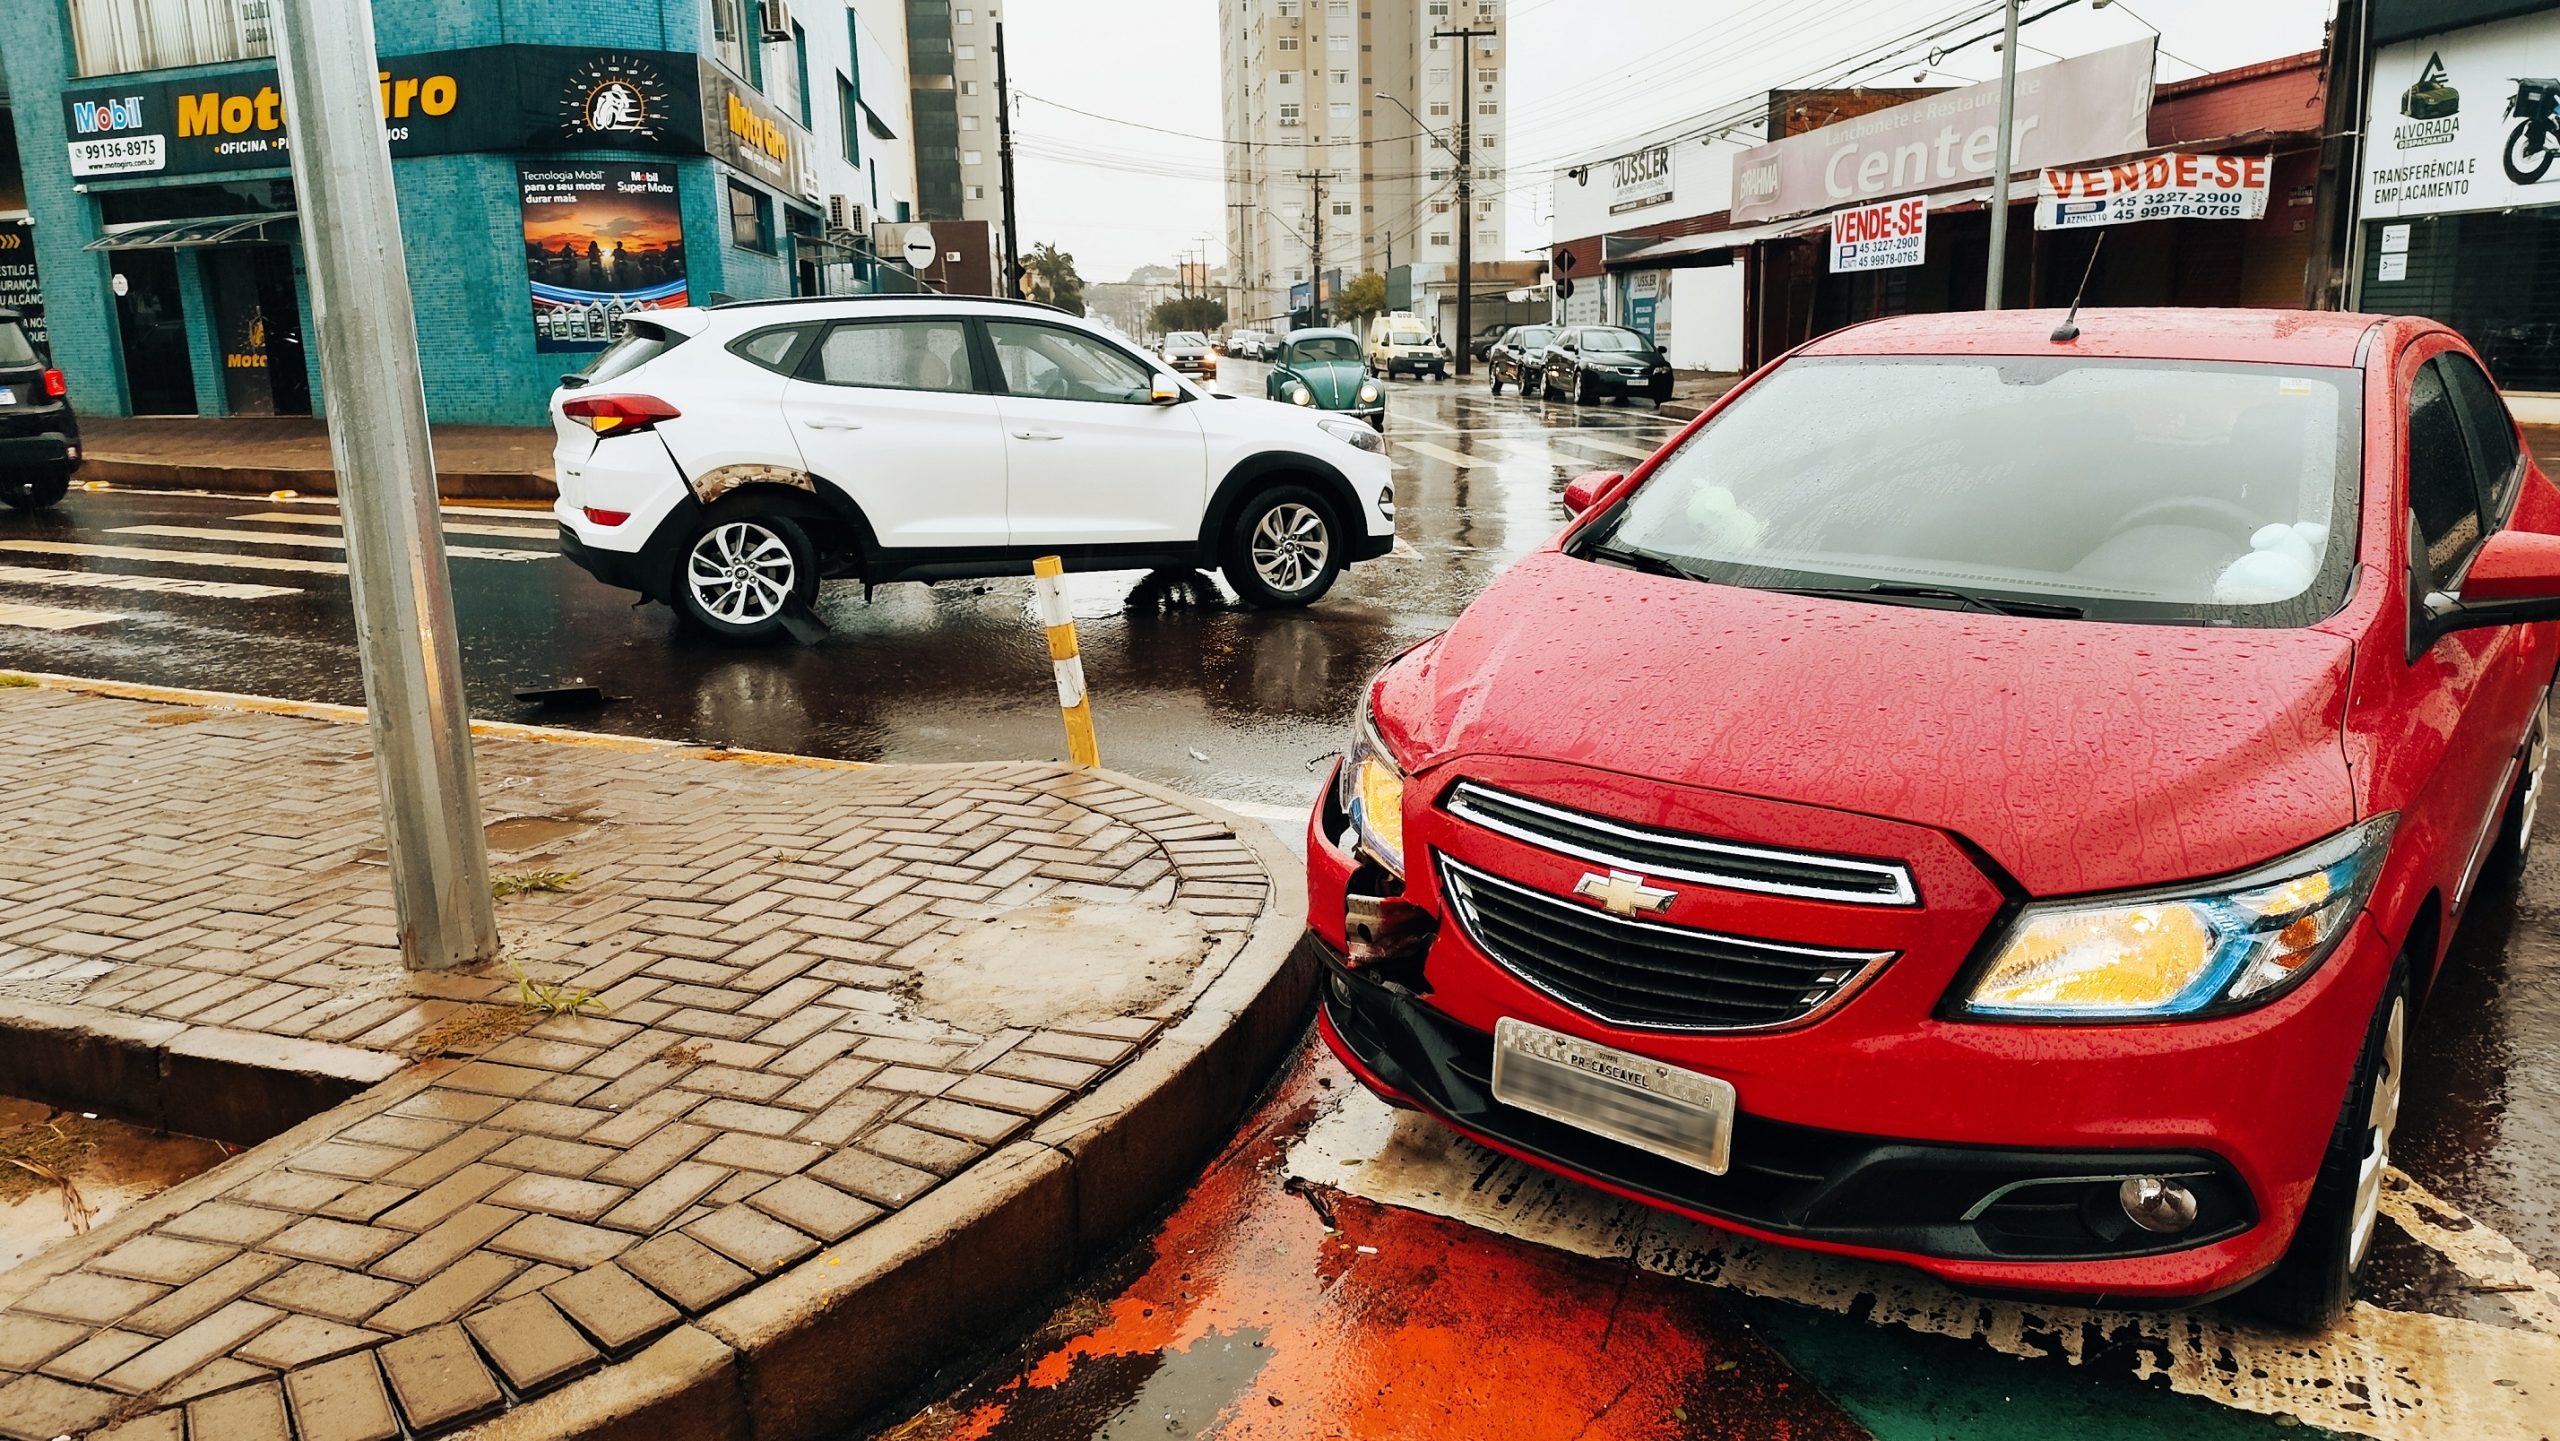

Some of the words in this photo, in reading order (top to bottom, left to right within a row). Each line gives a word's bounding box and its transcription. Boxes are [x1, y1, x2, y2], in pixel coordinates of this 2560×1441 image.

[74, 97, 143, 133] Mobil
[178, 86, 287, 137] Mot
[1825, 112, 1908, 146] Lanchonete
[1912, 111, 1922, 123] e
[1927, 80, 2040, 120] Restaurate
[728, 91, 762, 150] Moto
[763, 118, 787, 163] Giro
[2394, 117, 2460, 141] ALVORADA
[85, 140, 156, 159] 99136-8975
[220, 140, 267, 154] OFICINA
[2399, 134, 2451, 149] DESPACHANTE
[88, 158, 155, 170] www.motogiro.com.br
[1825, 115, 2040, 198] Center
[522, 171, 573, 182] Tecnologia
[630, 171, 659, 182] Mobil
[2047, 155, 2265, 199] VENDE-SE
[2373, 159, 2464, 185] TRANSFERÊNCIA
[2469, 158, 2476, 173] E
[524, 183, 546, 193] para
[556, 183, 574, 191] seu
[575, 182, 606, 191] motor
[617, 181, 646, 193] Super
[648, 183, 673, 193] Moto
[1740, 163, 1778, 200] BRAHMA
[525, 194, 551, 203] durar
[2112, 196, 2137, 207] 45
[2144, 192, 2242, 206] 3227-2900
[2375, 179, 2469, 204] EMPLACAMENTO
[2113, 209, 2135, 220] 45
[2140, 205, 2240, 218] 99978-0765
[1835, 200, 1923, 244] VENDE-SE
[1859, 243, 1869, 253] 45
[1872, 236, 1919, 252] 3227-2900
[1858, 256, 1868, 267] 45
[1870, 250, 1918, 266] 99978-0765
[28, 264, 35, 275] E
